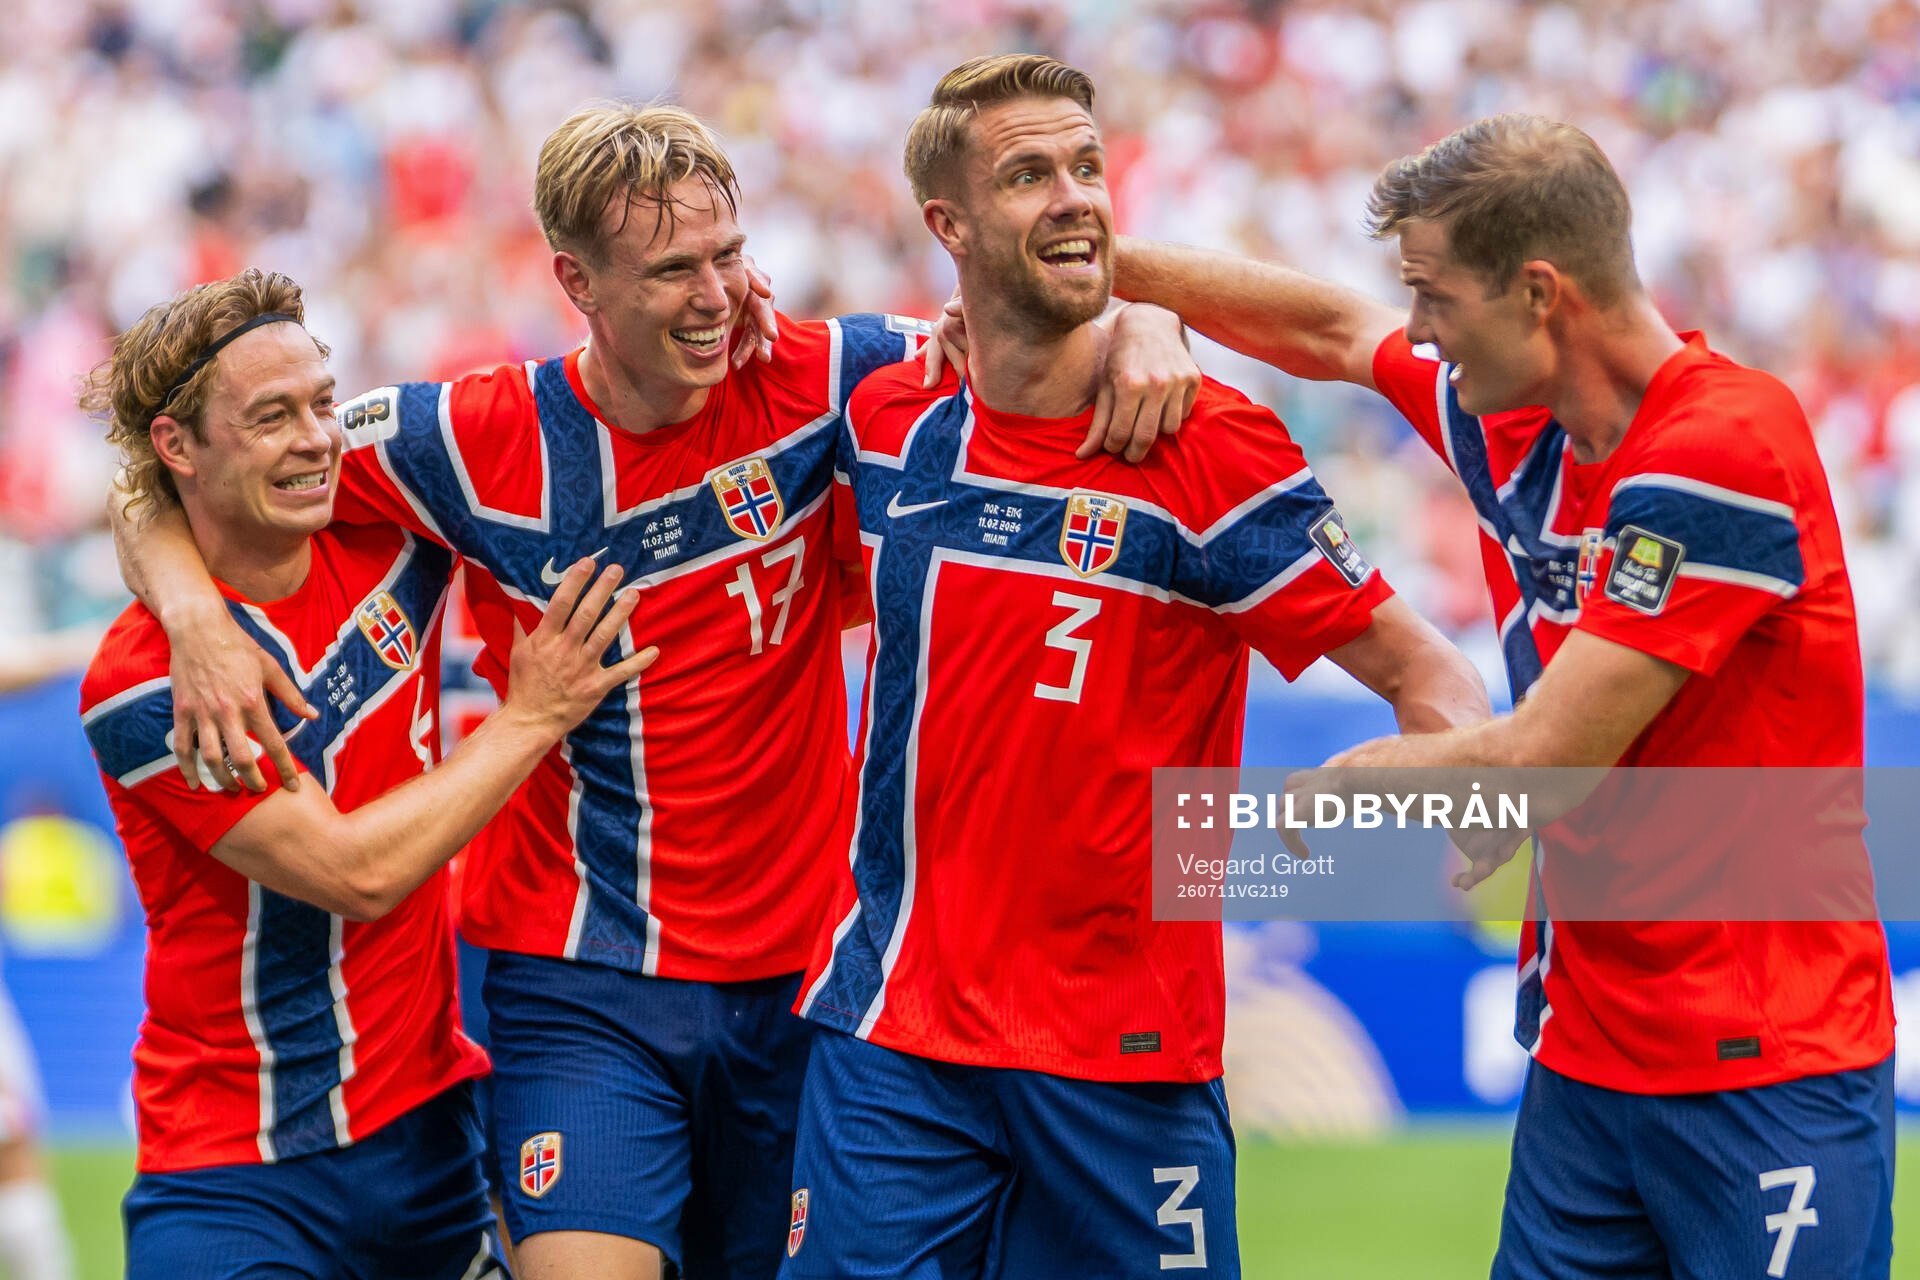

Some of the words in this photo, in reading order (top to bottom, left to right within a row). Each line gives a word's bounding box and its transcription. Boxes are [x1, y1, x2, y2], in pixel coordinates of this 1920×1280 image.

[983, 502, 1000, 515] NOR
[1006, 506, 1022, 519] ENG
[663, 514, 680, 528] ENG
[978, 516, 1021, 533] 11.07.2026
[982, 532, 1009, 546] MIAMI
[653, 543, 679, 560] MIAMI
[725, 535, 806, 656] 17
[1033, 590, 1102, 704] 3
[1153, 1165, 1208, 1270] 3
[1759, 1165, 1819, 1279] 7
